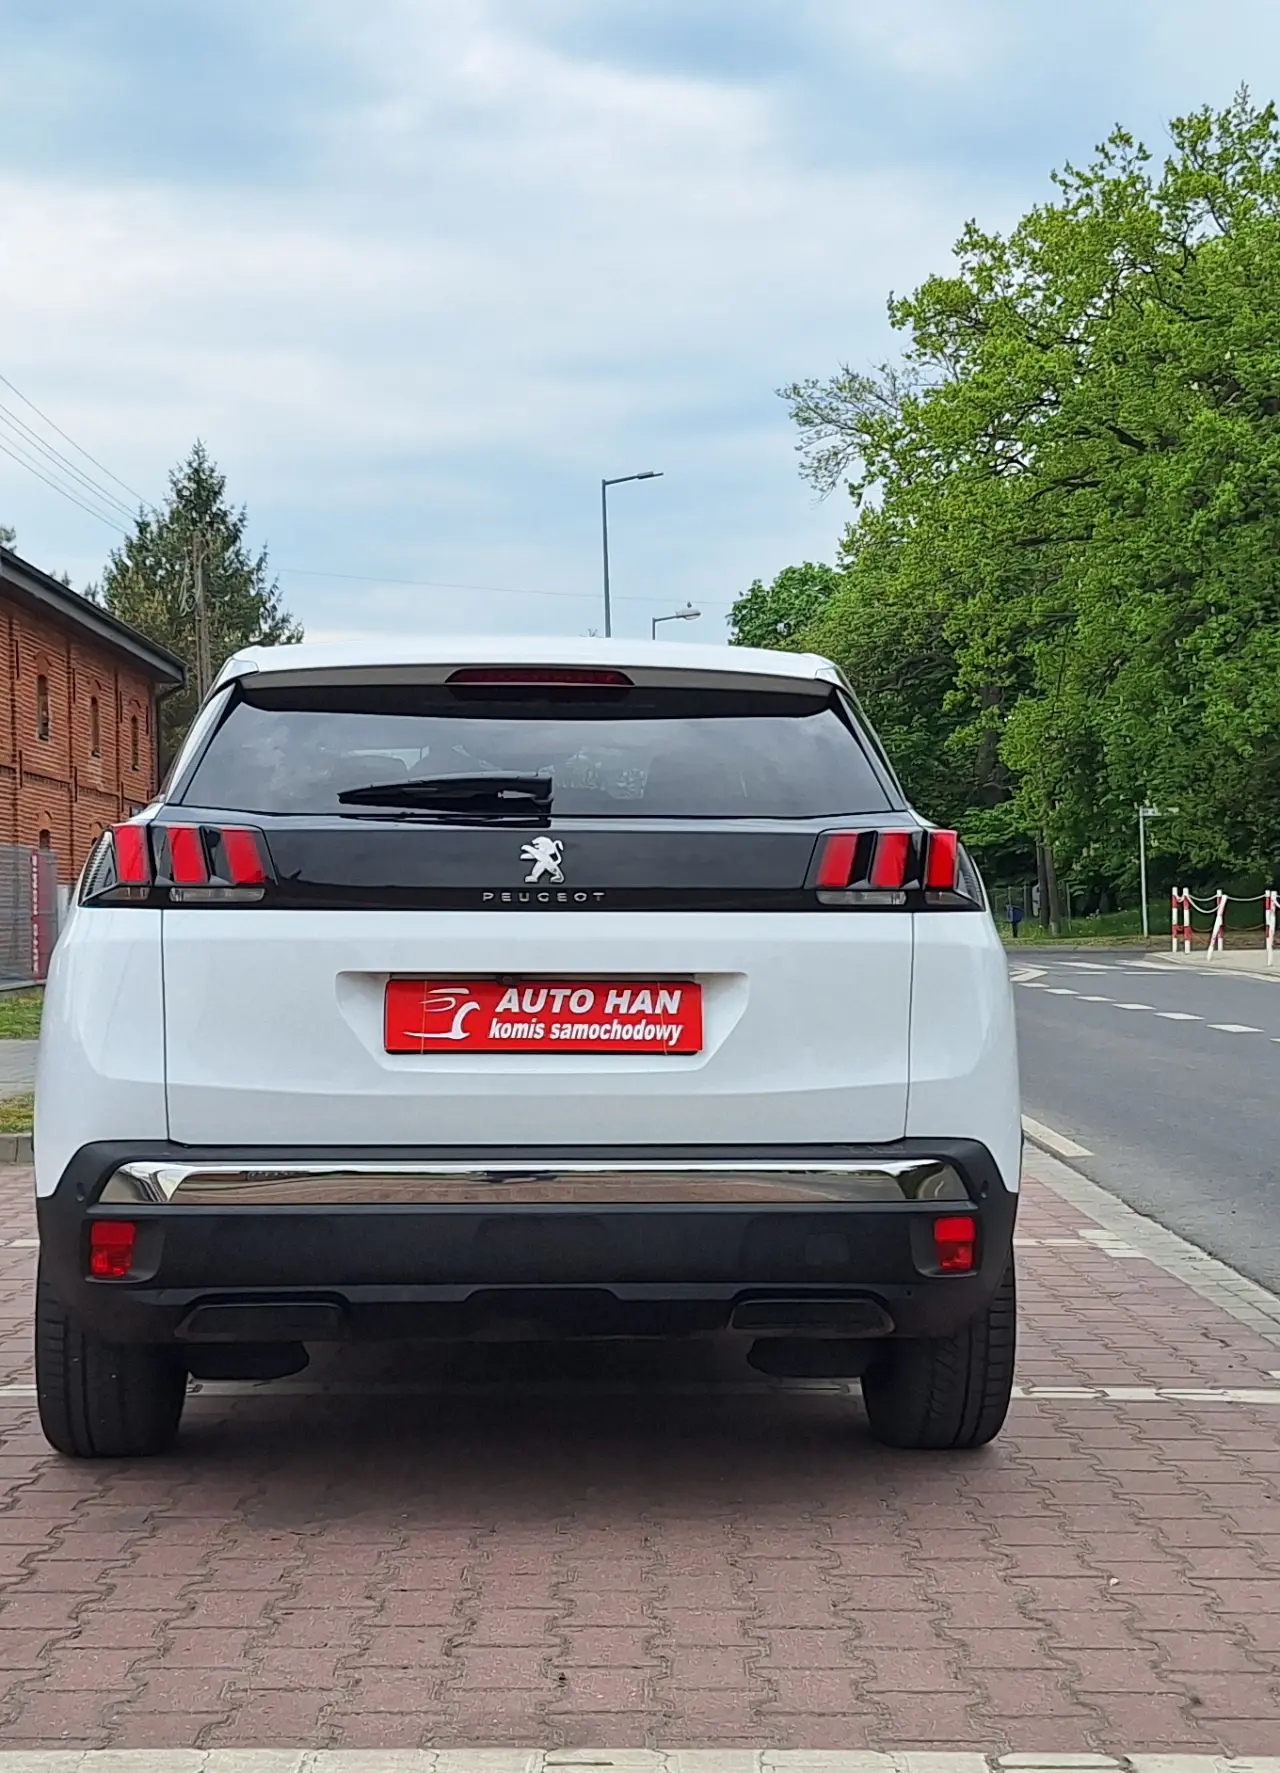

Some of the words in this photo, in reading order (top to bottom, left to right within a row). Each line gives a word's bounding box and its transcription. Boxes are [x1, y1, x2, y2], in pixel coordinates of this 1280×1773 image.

[482, 892, 605, 902] PEUGEOT
[495, 988, 598, 1014] AUTO
[604, 989, 682, 1015] HAN
[489, 1018, 544, 1040] komis
[549, 1020, 683, 1046] samochodowy
